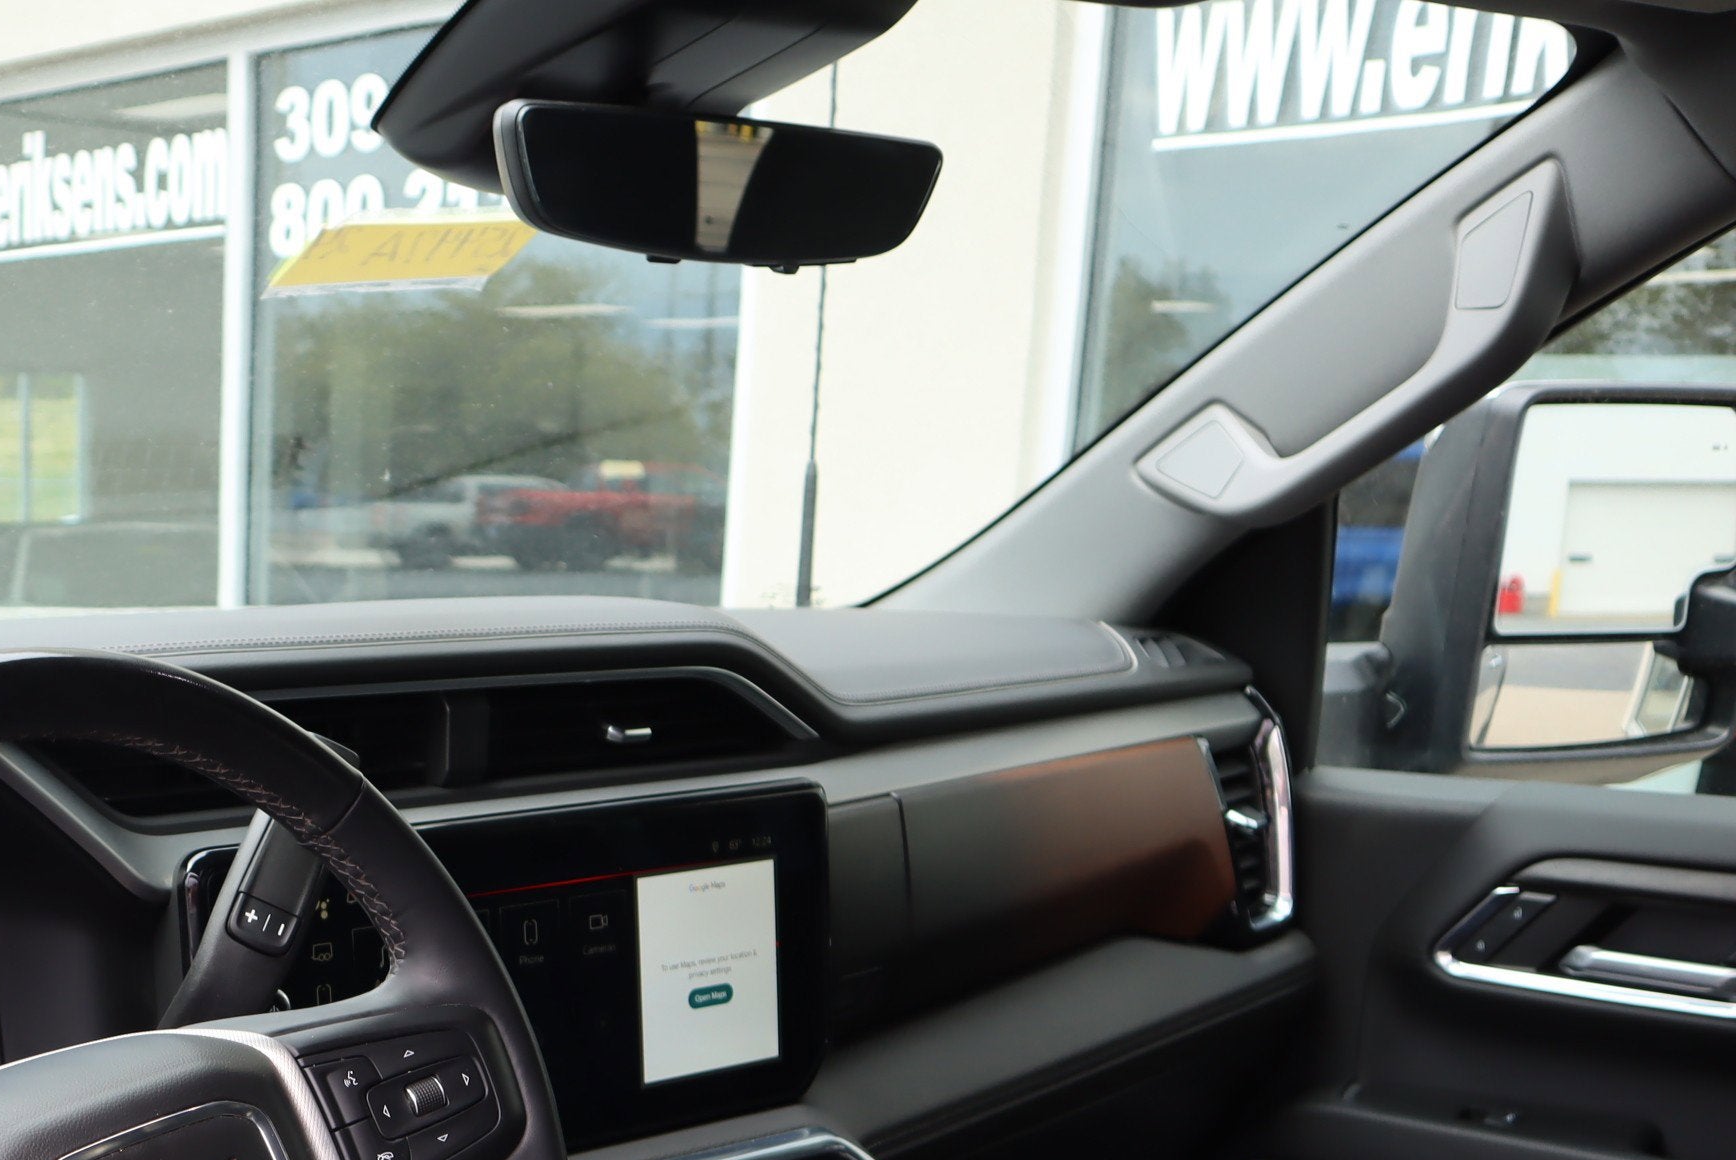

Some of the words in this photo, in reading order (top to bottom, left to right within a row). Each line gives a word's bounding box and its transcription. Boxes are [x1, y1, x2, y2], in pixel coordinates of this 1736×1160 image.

[274, 73, 388, 163] 309
[519, 955, 544, 965] Phone
[717, 955, 729, 964] your
[730, 951, 752, 960] location
[688, 969, 709, 979] privacy
[694, 992, 711, 1003] Open
[711, 990, 727, 1000] Maps
